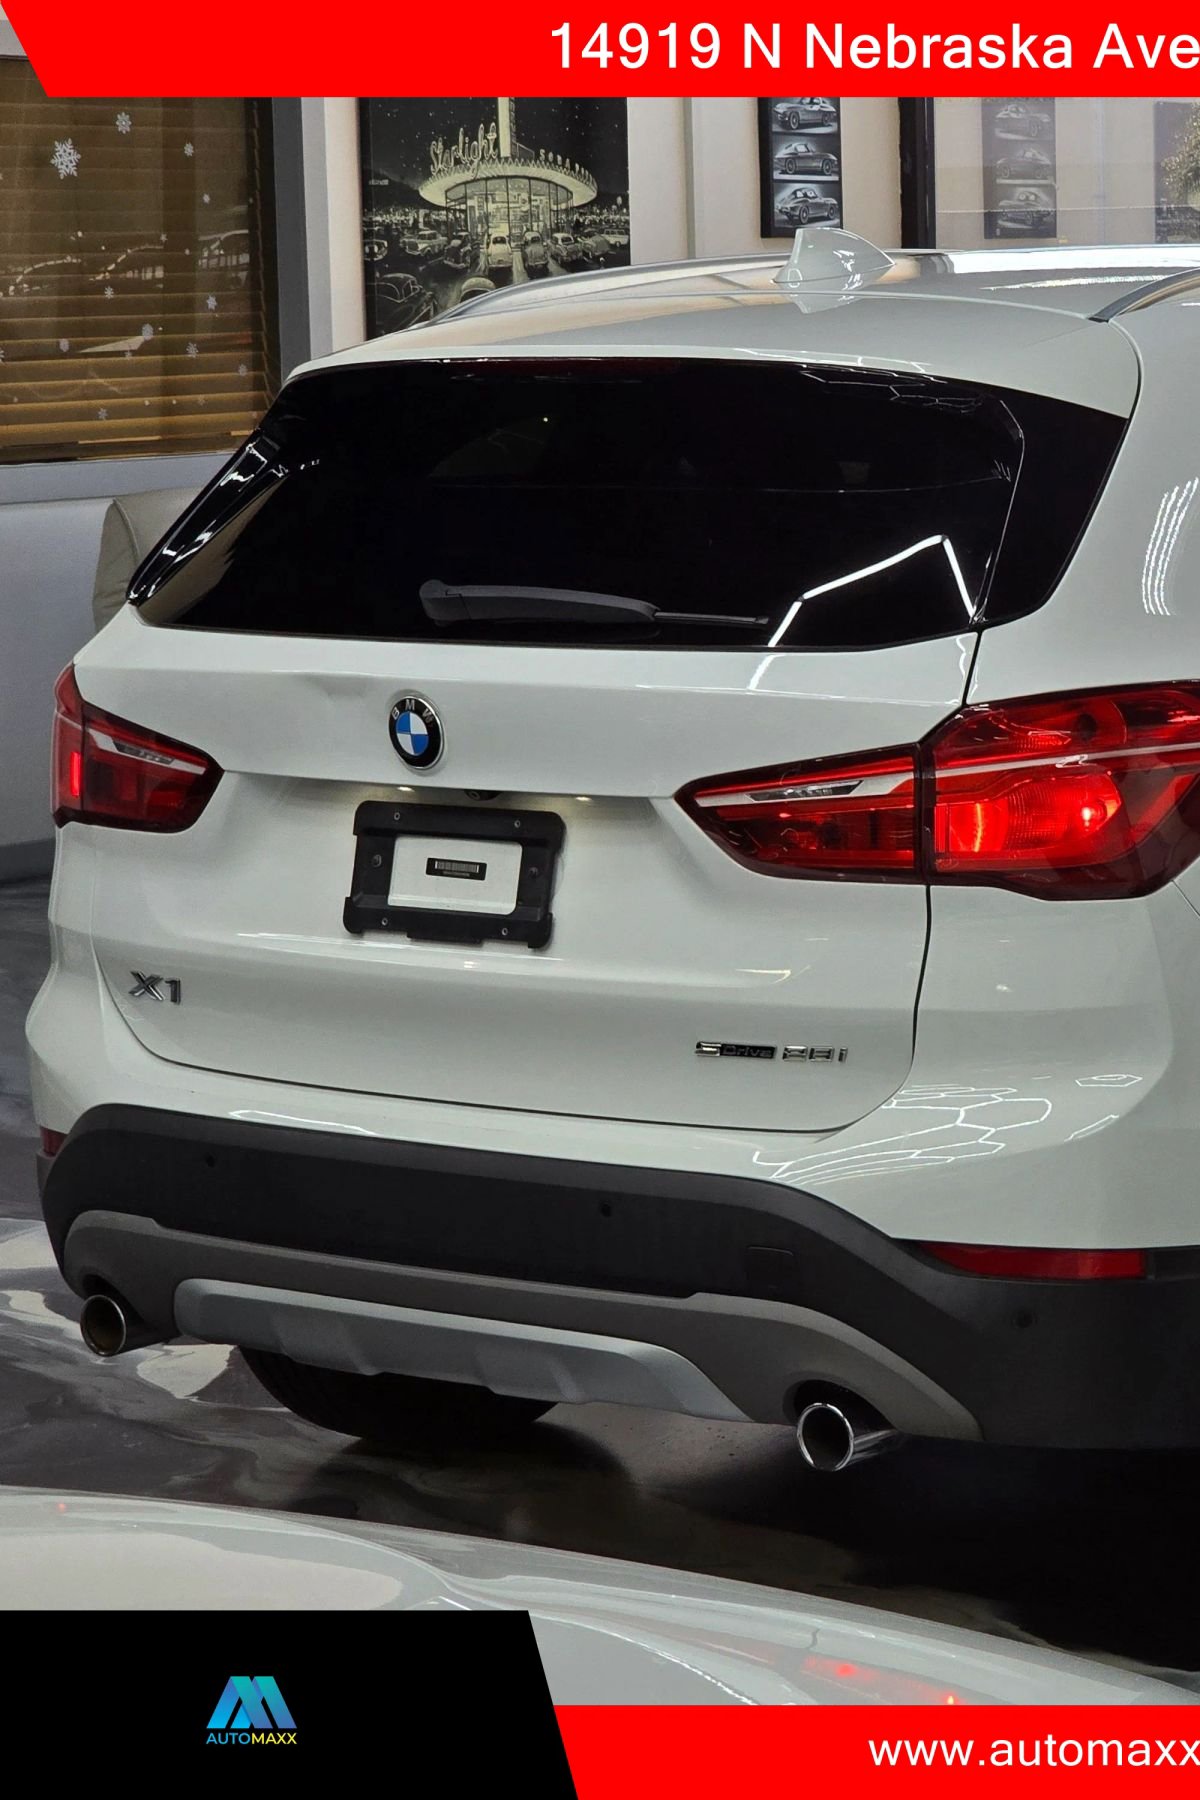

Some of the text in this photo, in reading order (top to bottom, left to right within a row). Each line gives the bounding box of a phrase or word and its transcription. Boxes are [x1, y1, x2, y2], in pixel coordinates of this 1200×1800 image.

[430, 122, 498, 180] Starlight
[391, 698, 434, 725] BMW
[128, 971, 181, 1005] X1
